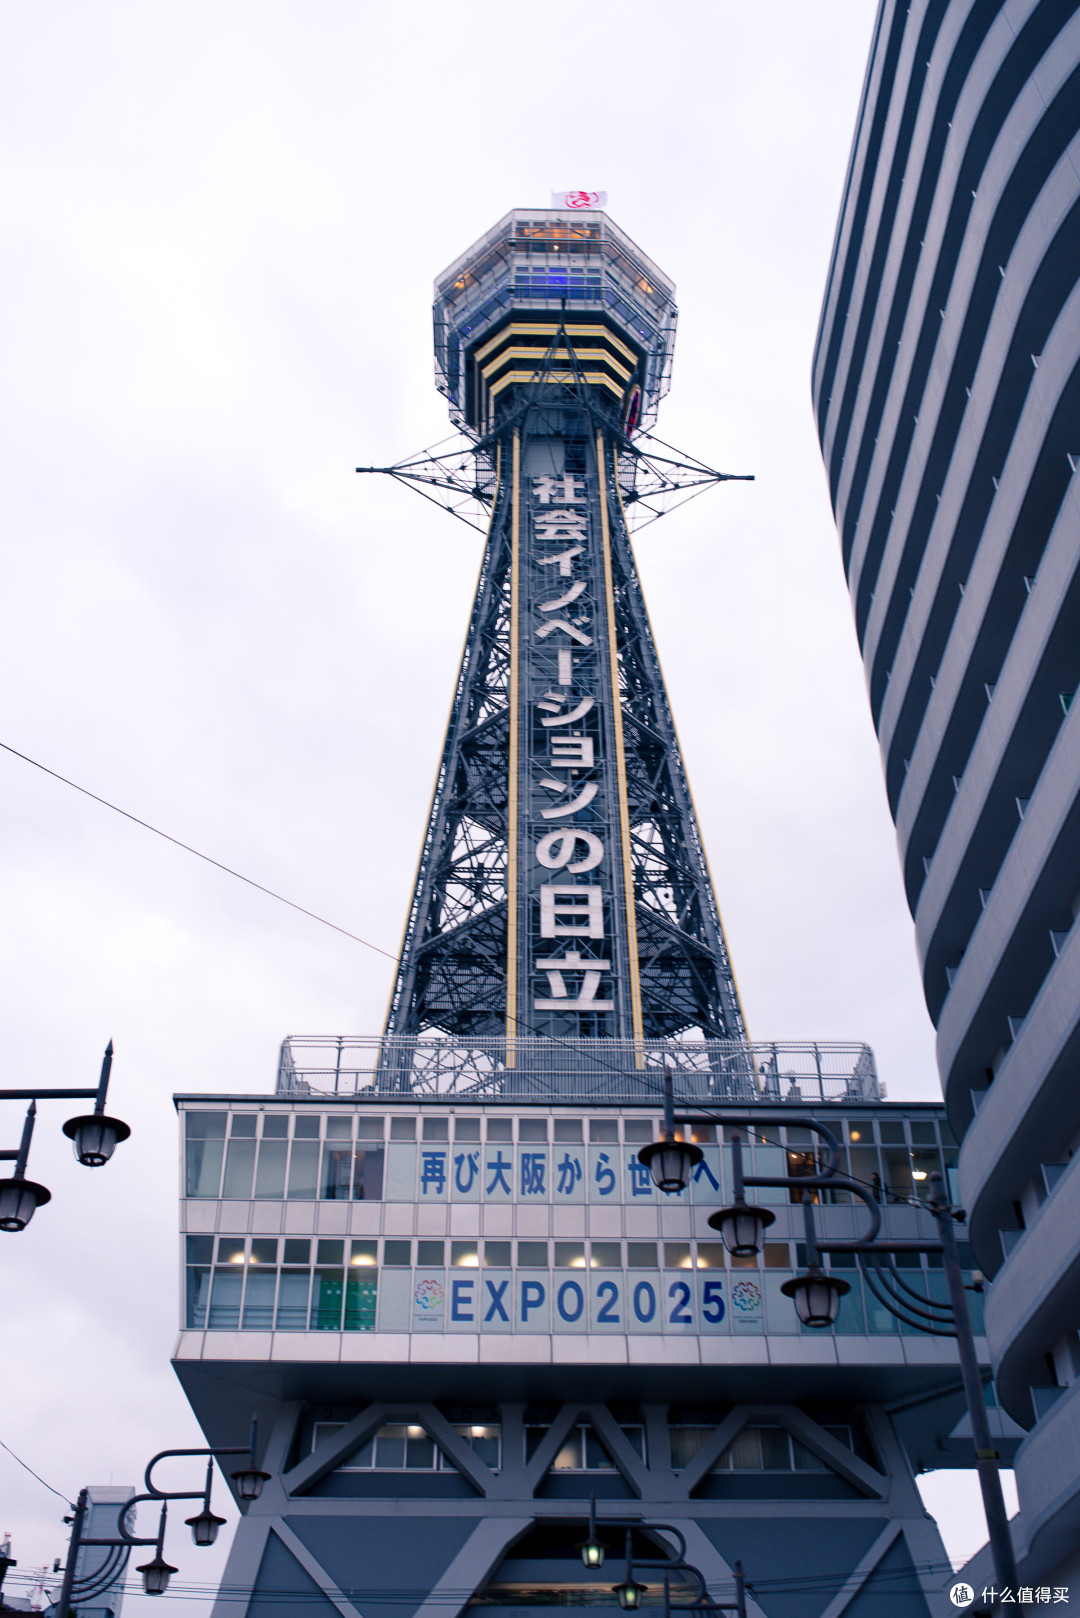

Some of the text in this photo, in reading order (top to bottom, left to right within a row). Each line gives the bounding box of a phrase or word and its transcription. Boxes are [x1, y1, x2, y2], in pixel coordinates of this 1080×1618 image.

[532, 475, 614, 1011] 社会イノベーションの日立
[421, 1151, 719, 1196] 再び大阪から世へ
[451, 1280, 724, 1323] EXPO2025
